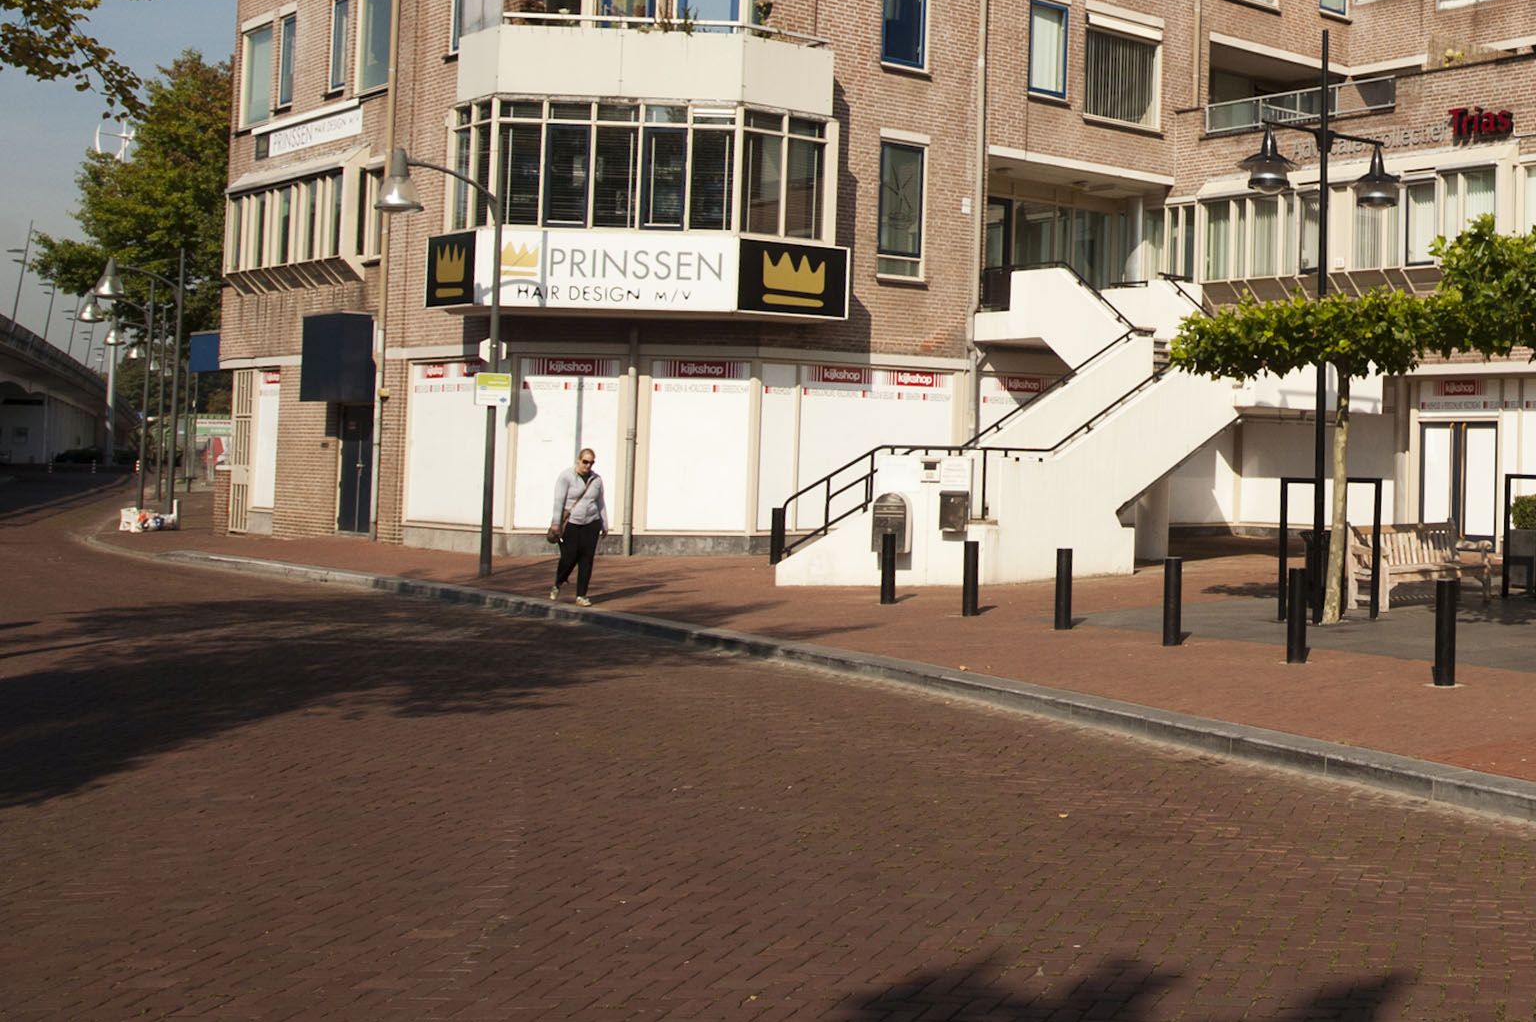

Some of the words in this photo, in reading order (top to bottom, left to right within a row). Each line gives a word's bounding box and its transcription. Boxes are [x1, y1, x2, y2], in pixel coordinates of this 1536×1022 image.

[1448, 106, 1513, 136] Trias
[549, 248, 723, 281] PRINSSEN
[517, 285, 560, 300] HAIR
[568, 286, 640, 302] DESIGN
[548, 359, 592, 374] kijkshop
[680, 362, 724, 376] kijkshop
[823, 367, 860, 382] kijkshop
[897, 371, 934, 386] kijkshop
